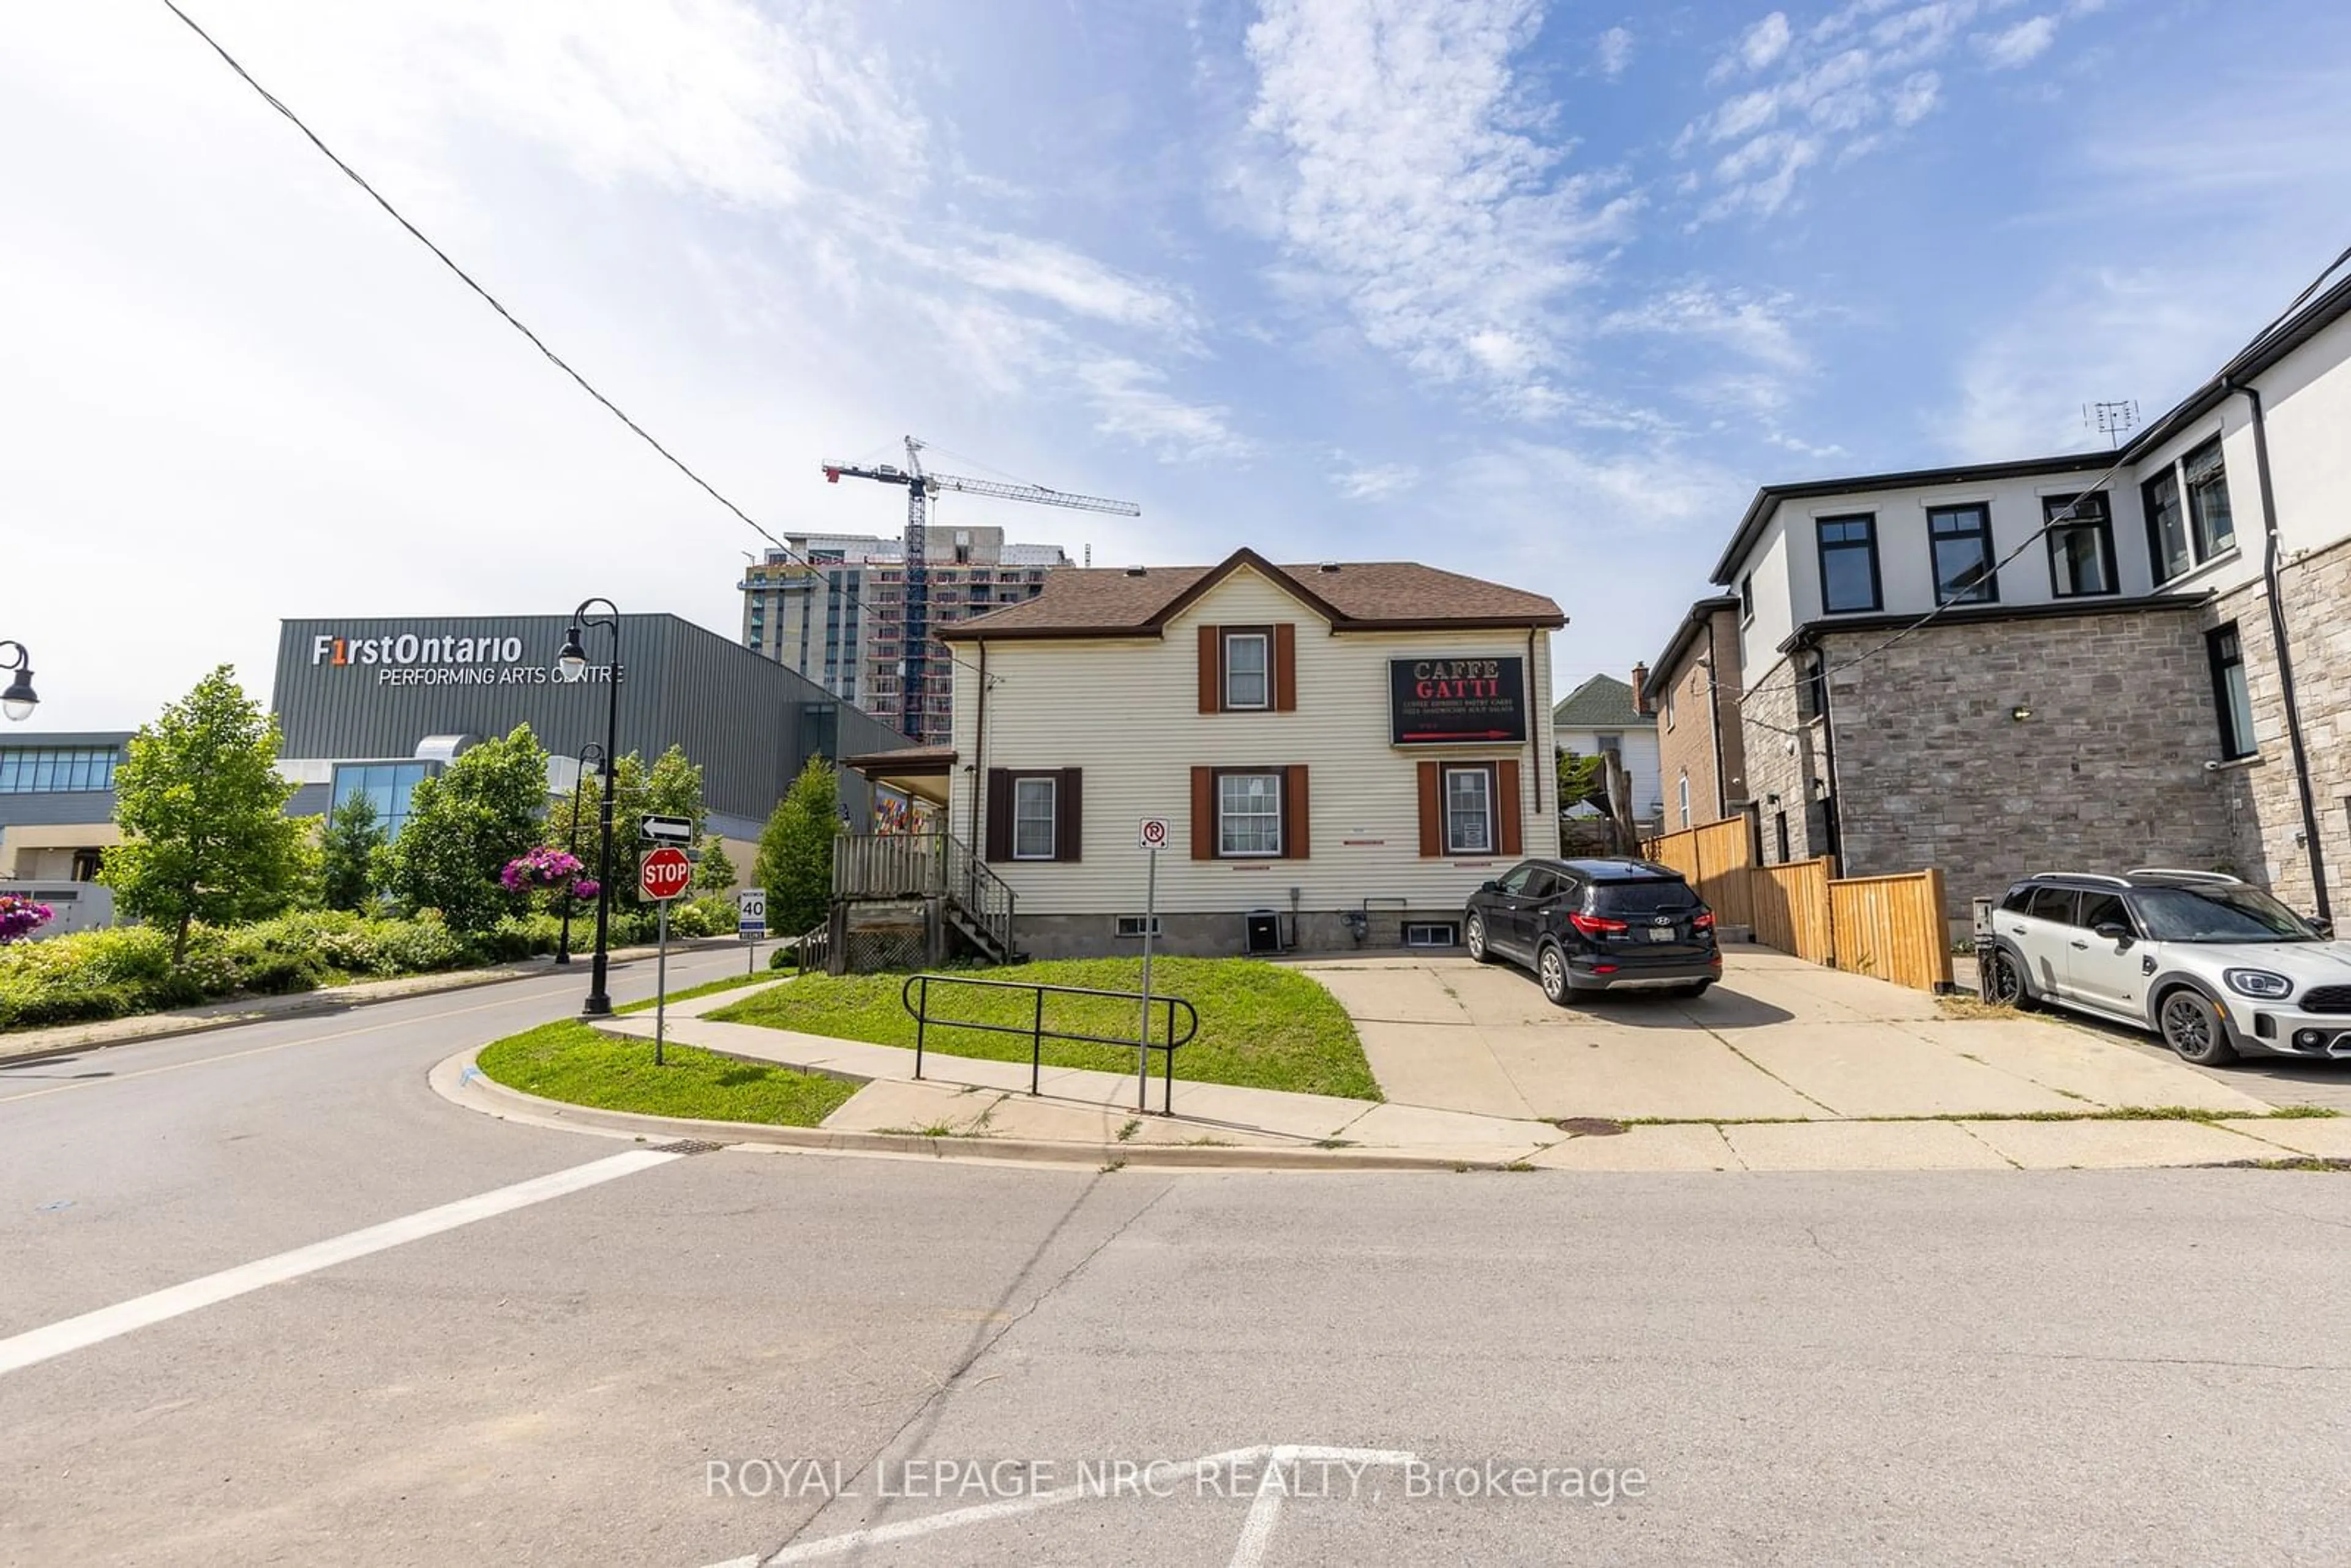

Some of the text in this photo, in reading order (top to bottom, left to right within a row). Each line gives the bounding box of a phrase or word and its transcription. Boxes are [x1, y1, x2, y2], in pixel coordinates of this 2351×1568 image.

[379, 666, 624, 686] PERFORMING ARTS CNTRE
[1414, 661, 1499, 680] CAFFE
[1416, 680, 1499, 699] GATTI
[645, 863, 687, 883] STOP
[742, 901, 763, 916] 40
